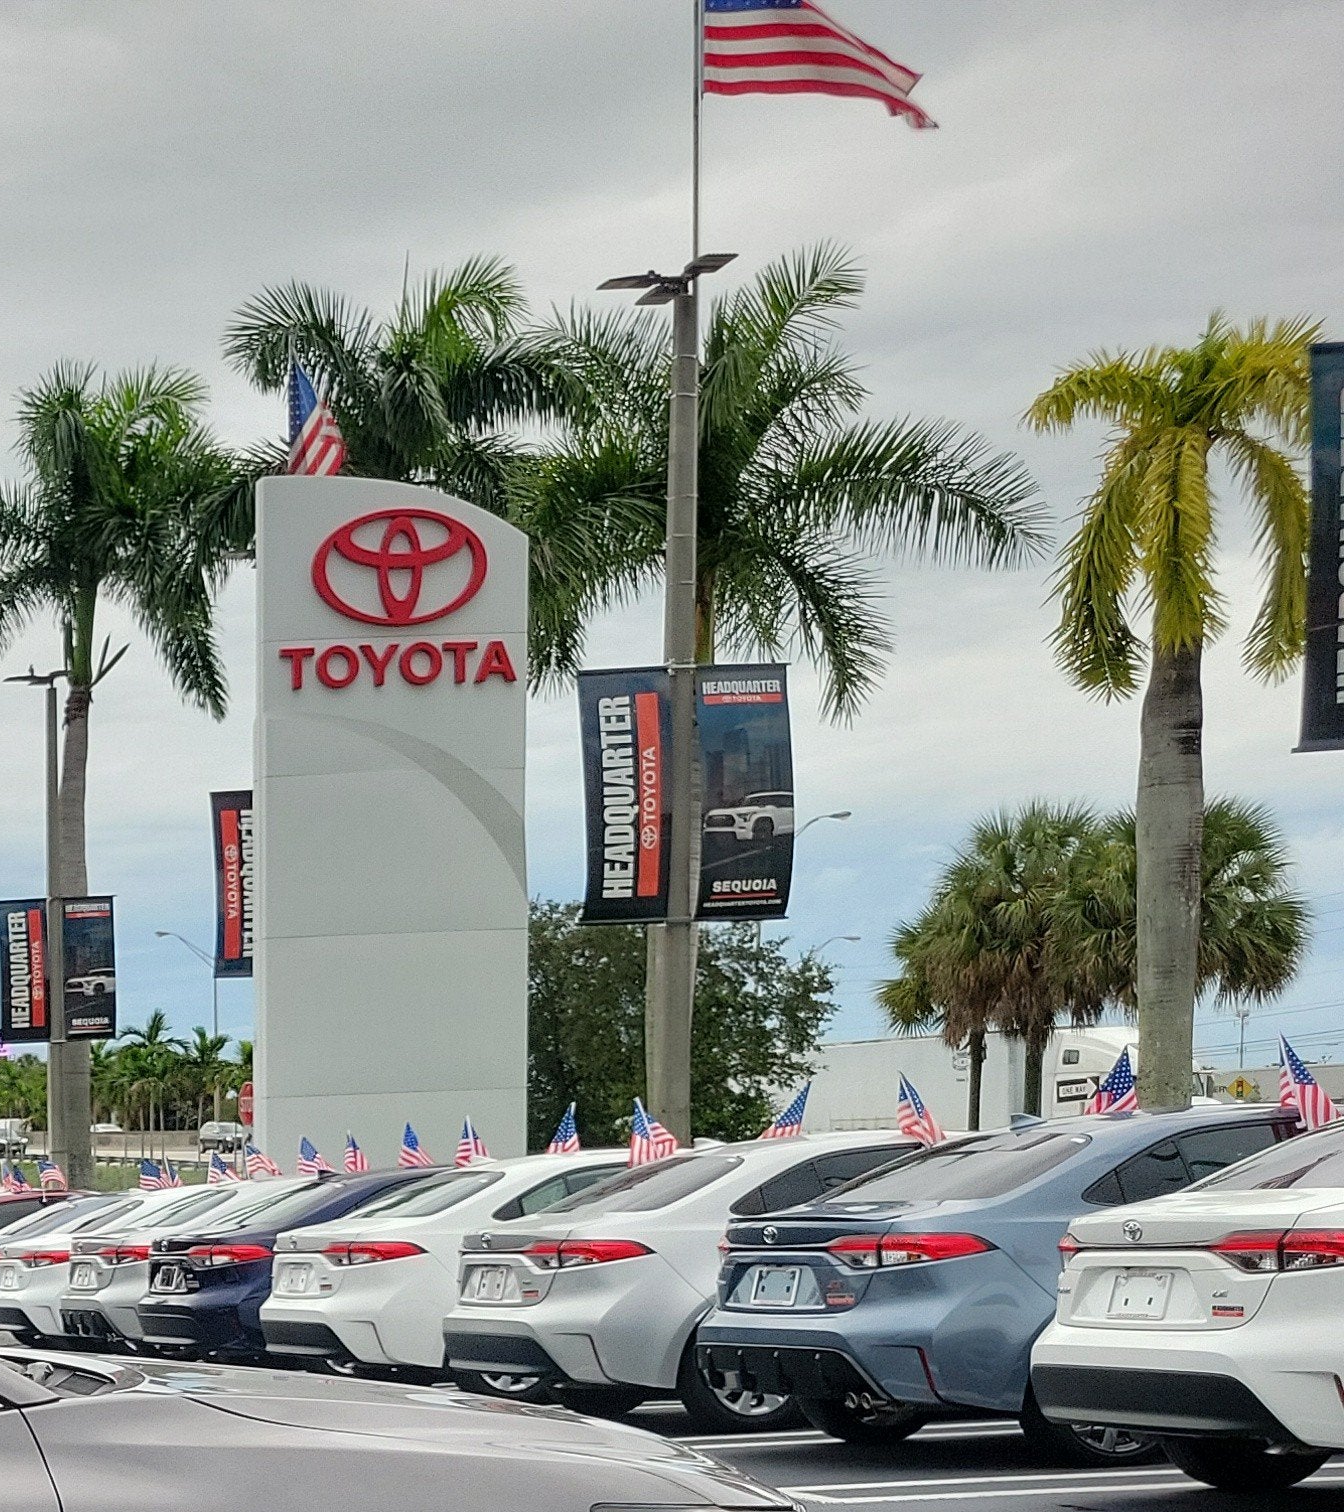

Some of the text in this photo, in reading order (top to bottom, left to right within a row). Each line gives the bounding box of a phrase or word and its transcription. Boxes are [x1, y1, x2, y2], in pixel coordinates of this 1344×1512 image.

[279, 641, 517, 690] TOYOTA
[702, 680, 781, 695] HEADQUARTER
[598, 695, 639, 898] HEADQUARTER
[641, 746, 657, 824] TOYOTA
[227, 865, 239, 919] TOYOTA
[712, 878, 777, 893] SEQUOIA
[7, 911, 31, 1029] HEADQUARTER
[31, 941, 42, 986] TOYOTA
